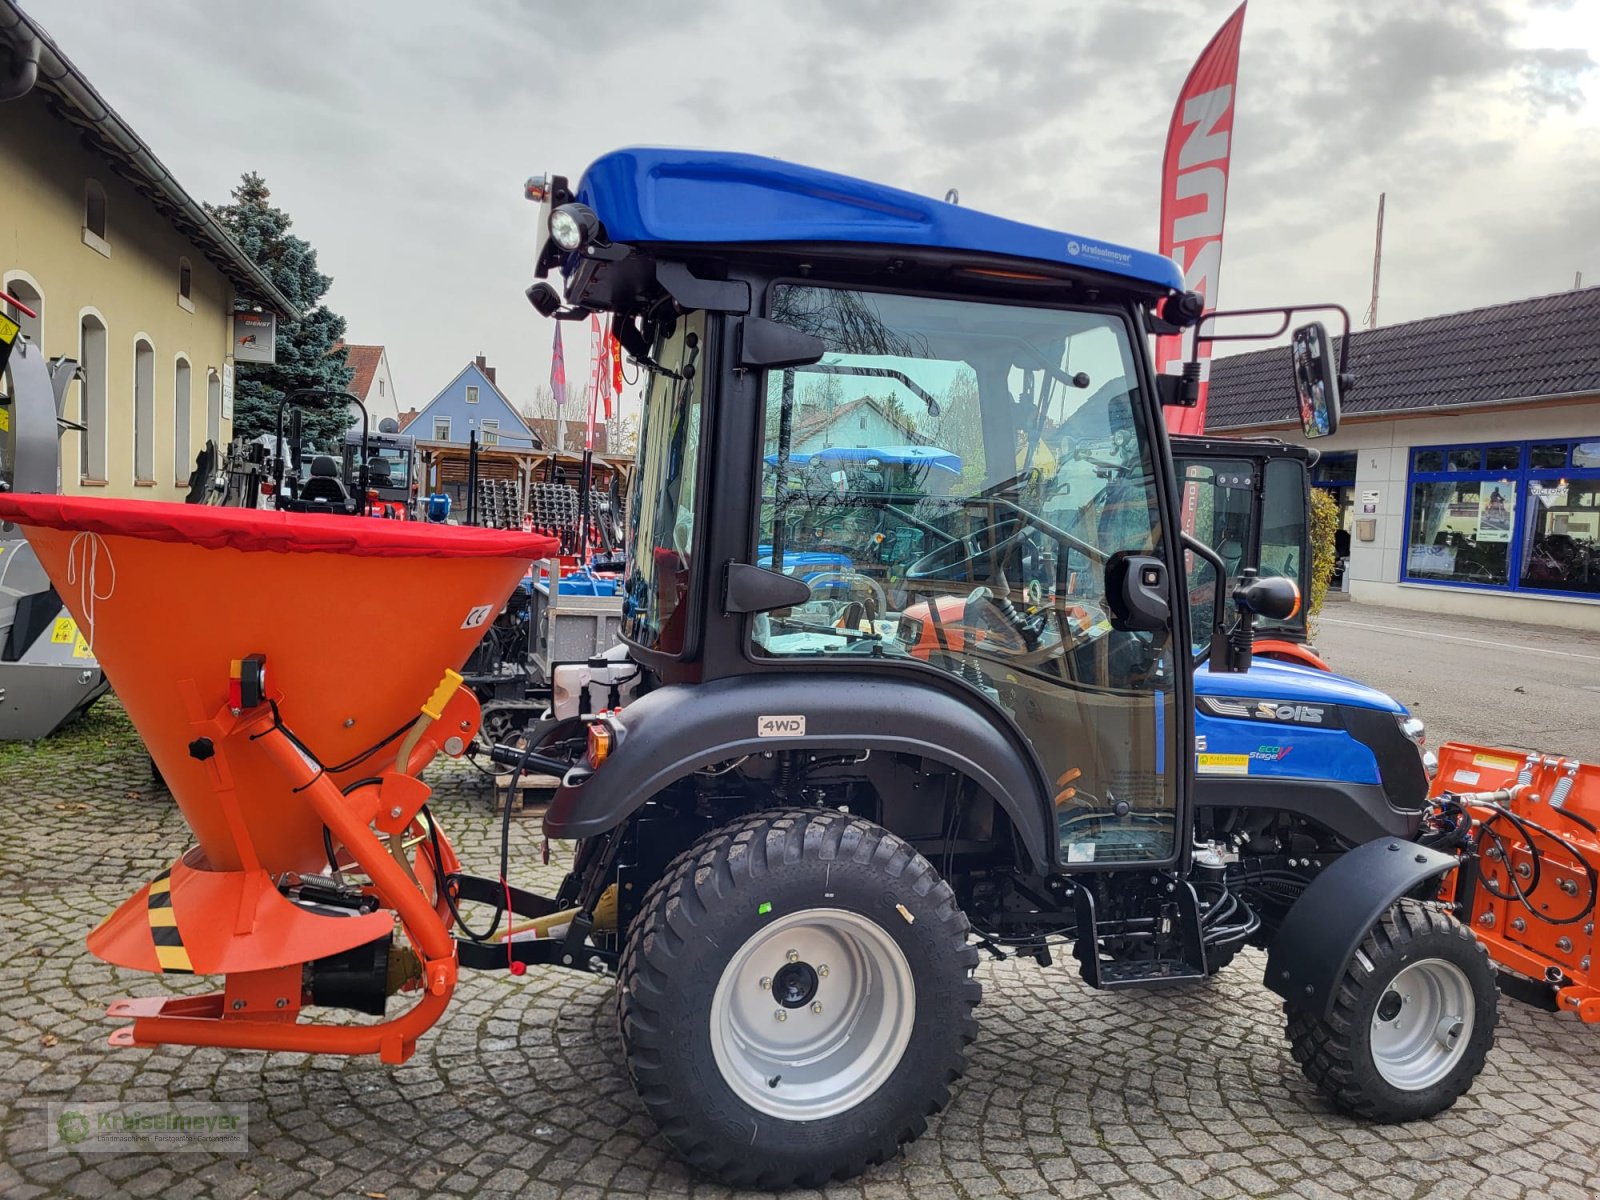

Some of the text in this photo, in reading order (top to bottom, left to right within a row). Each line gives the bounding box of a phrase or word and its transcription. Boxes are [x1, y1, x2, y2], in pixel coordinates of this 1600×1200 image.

[1531, 488, 1569, 496] VICTORY
[763, 720, 800, 732] 4WD
[1248, 746, 1293, 761] Stage V
